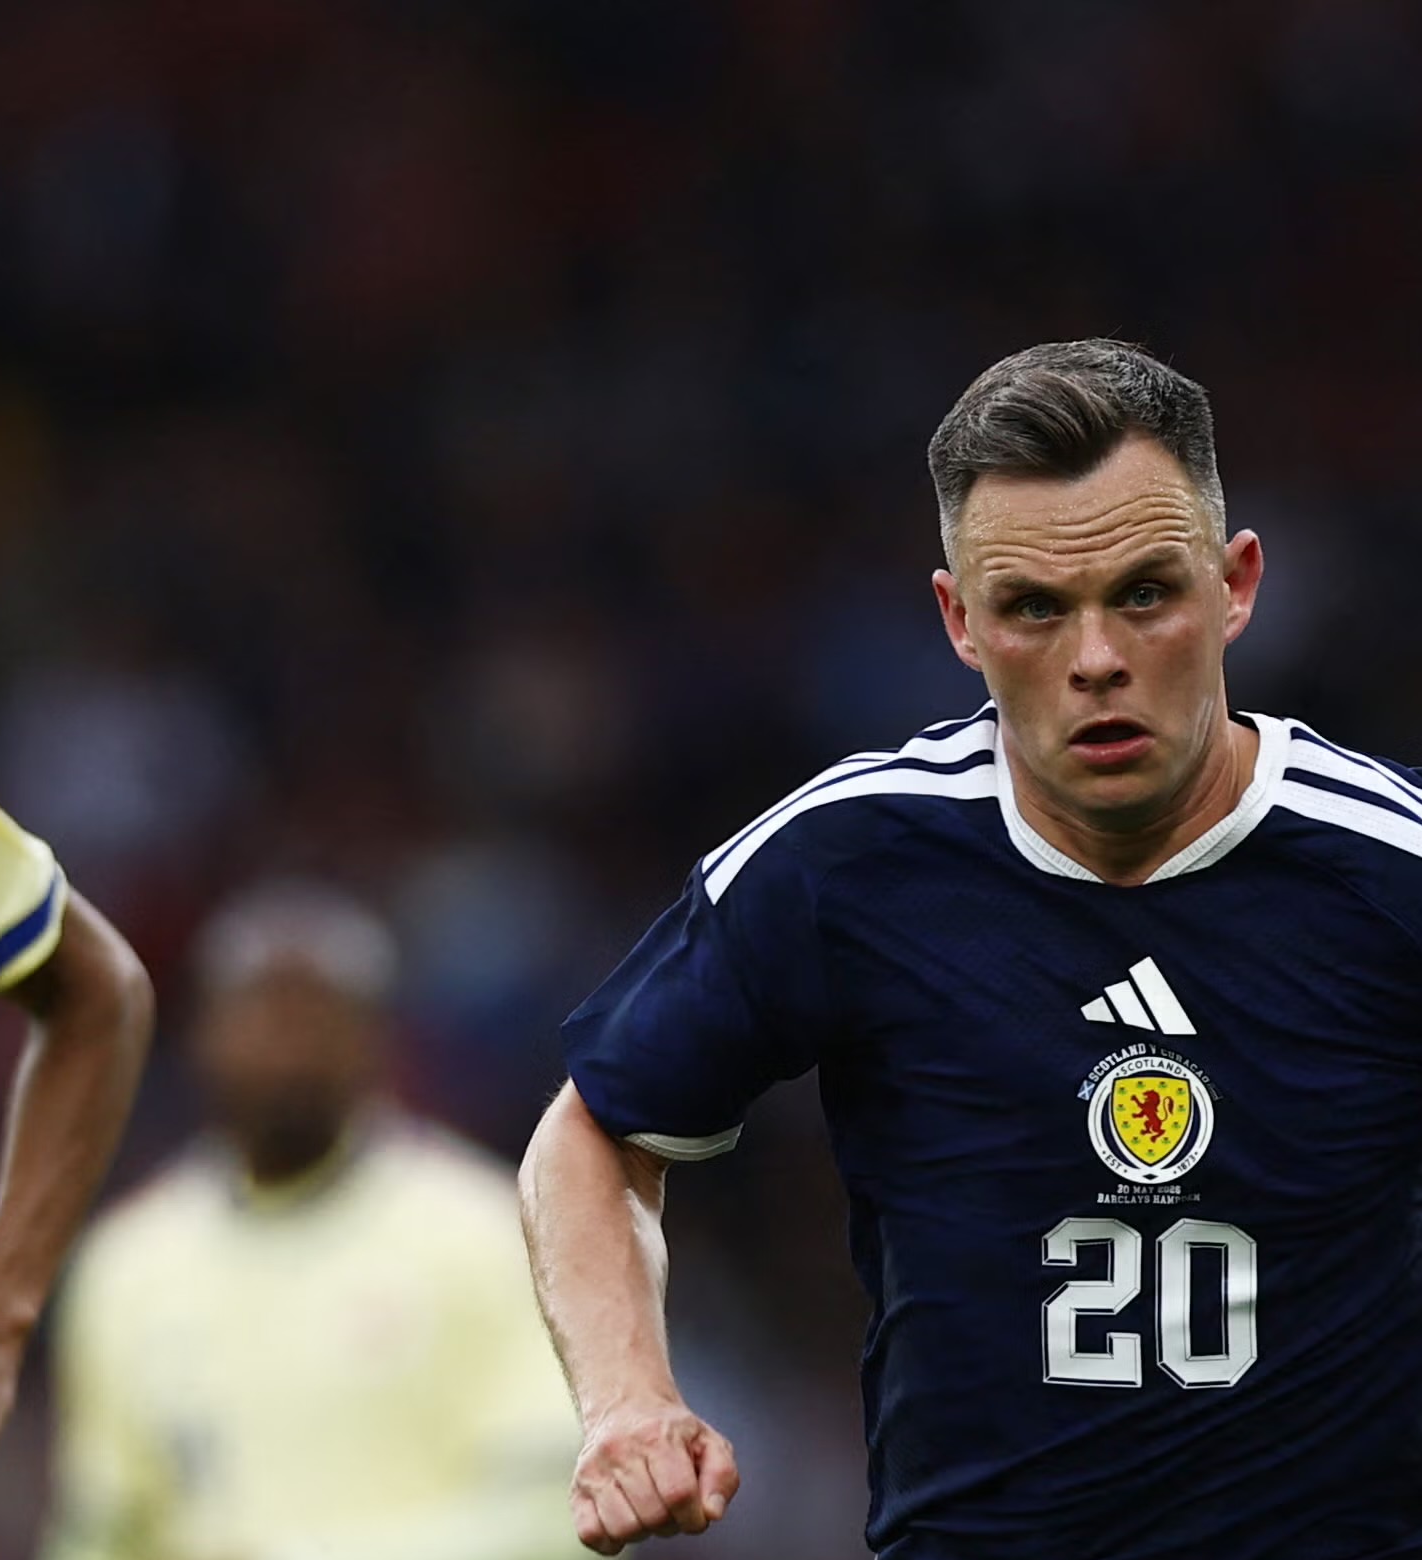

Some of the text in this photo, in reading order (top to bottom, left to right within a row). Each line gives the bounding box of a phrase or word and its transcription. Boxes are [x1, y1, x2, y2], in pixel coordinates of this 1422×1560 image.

[1088, 1043, 1147, 1082] SCOTLAND
[1121, 1060, 1182, 1076] SCOTLAND
[1105, 1154, 1196, 1172] EST 1873
[1117, 1184, 1130, 1194] 20
[1133, 1185, 1154, 1194] MAY
[1097, 1193, 1151, 1204] BARCLAYS
[1042, 1217, 1258, 1389] 20
